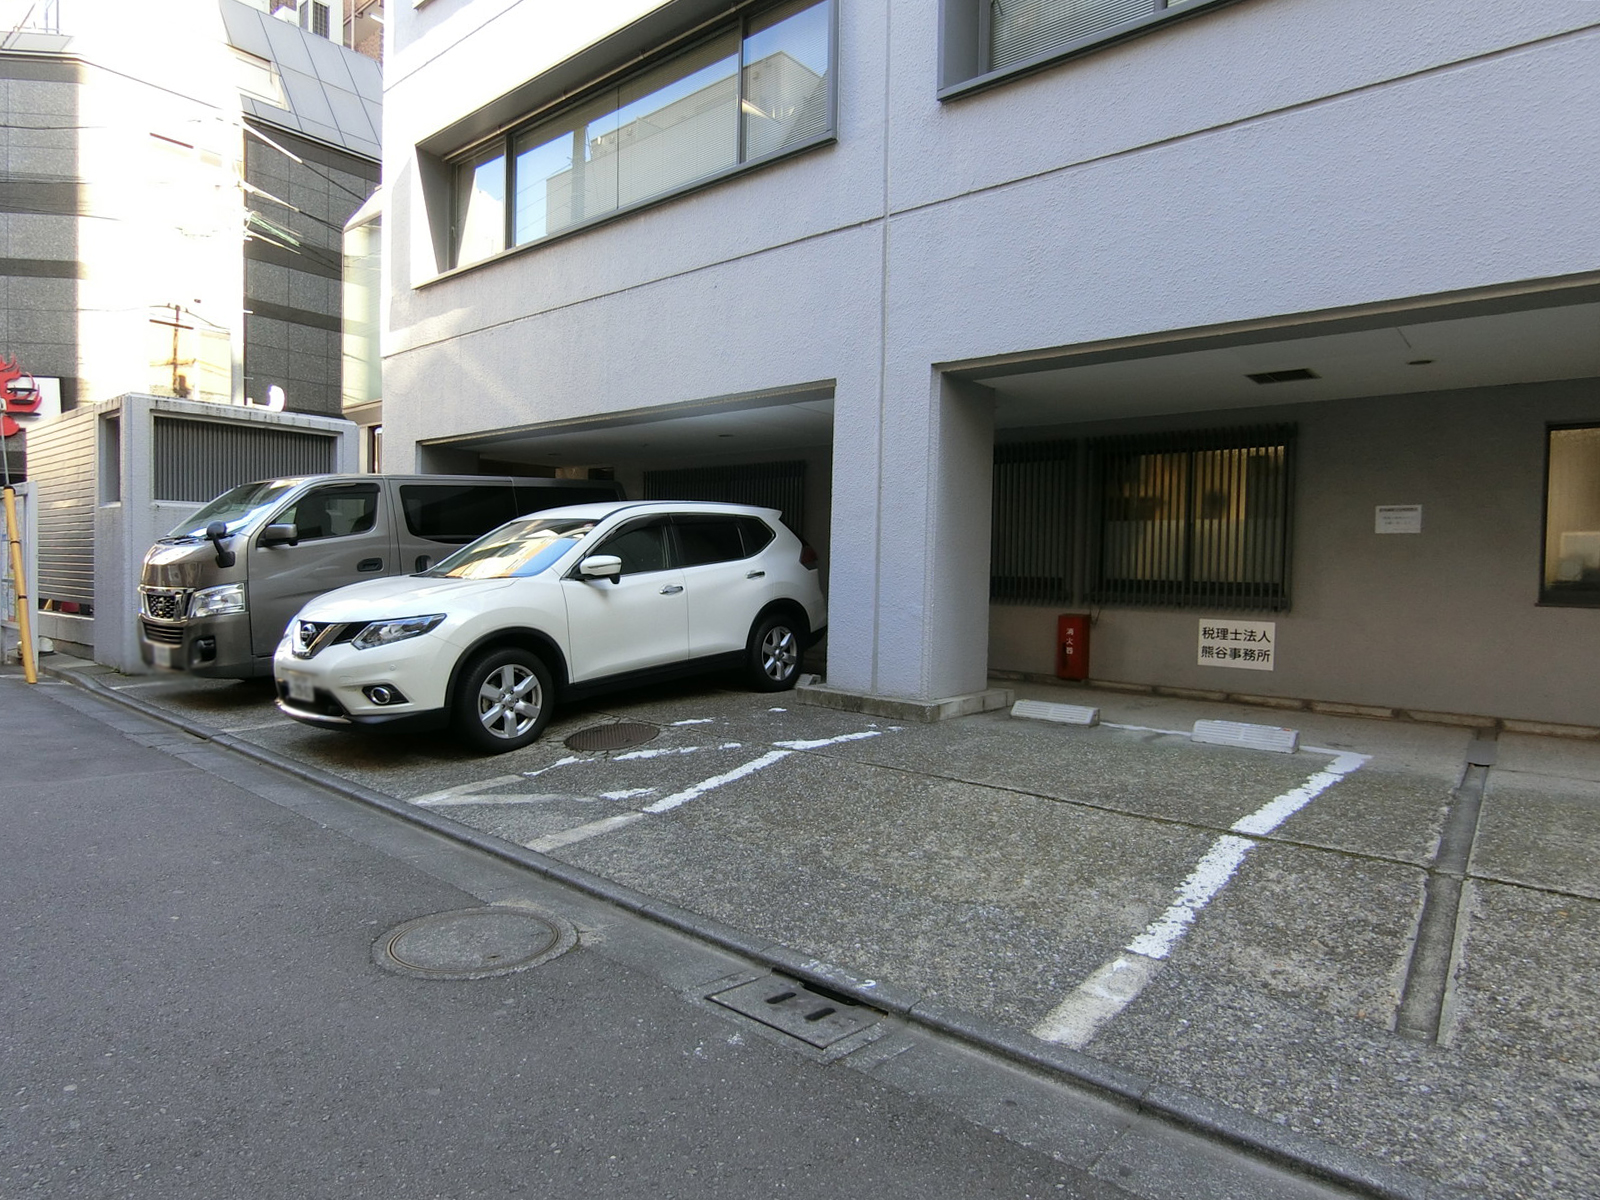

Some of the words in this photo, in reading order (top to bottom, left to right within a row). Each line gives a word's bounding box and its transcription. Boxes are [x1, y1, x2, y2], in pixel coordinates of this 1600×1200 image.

[1066, 628, 1074, 655] 消火器
[1202, 627, 1271, 643] 税理士法人
[1201, 645, 1271, 663] 熊谷事務所
